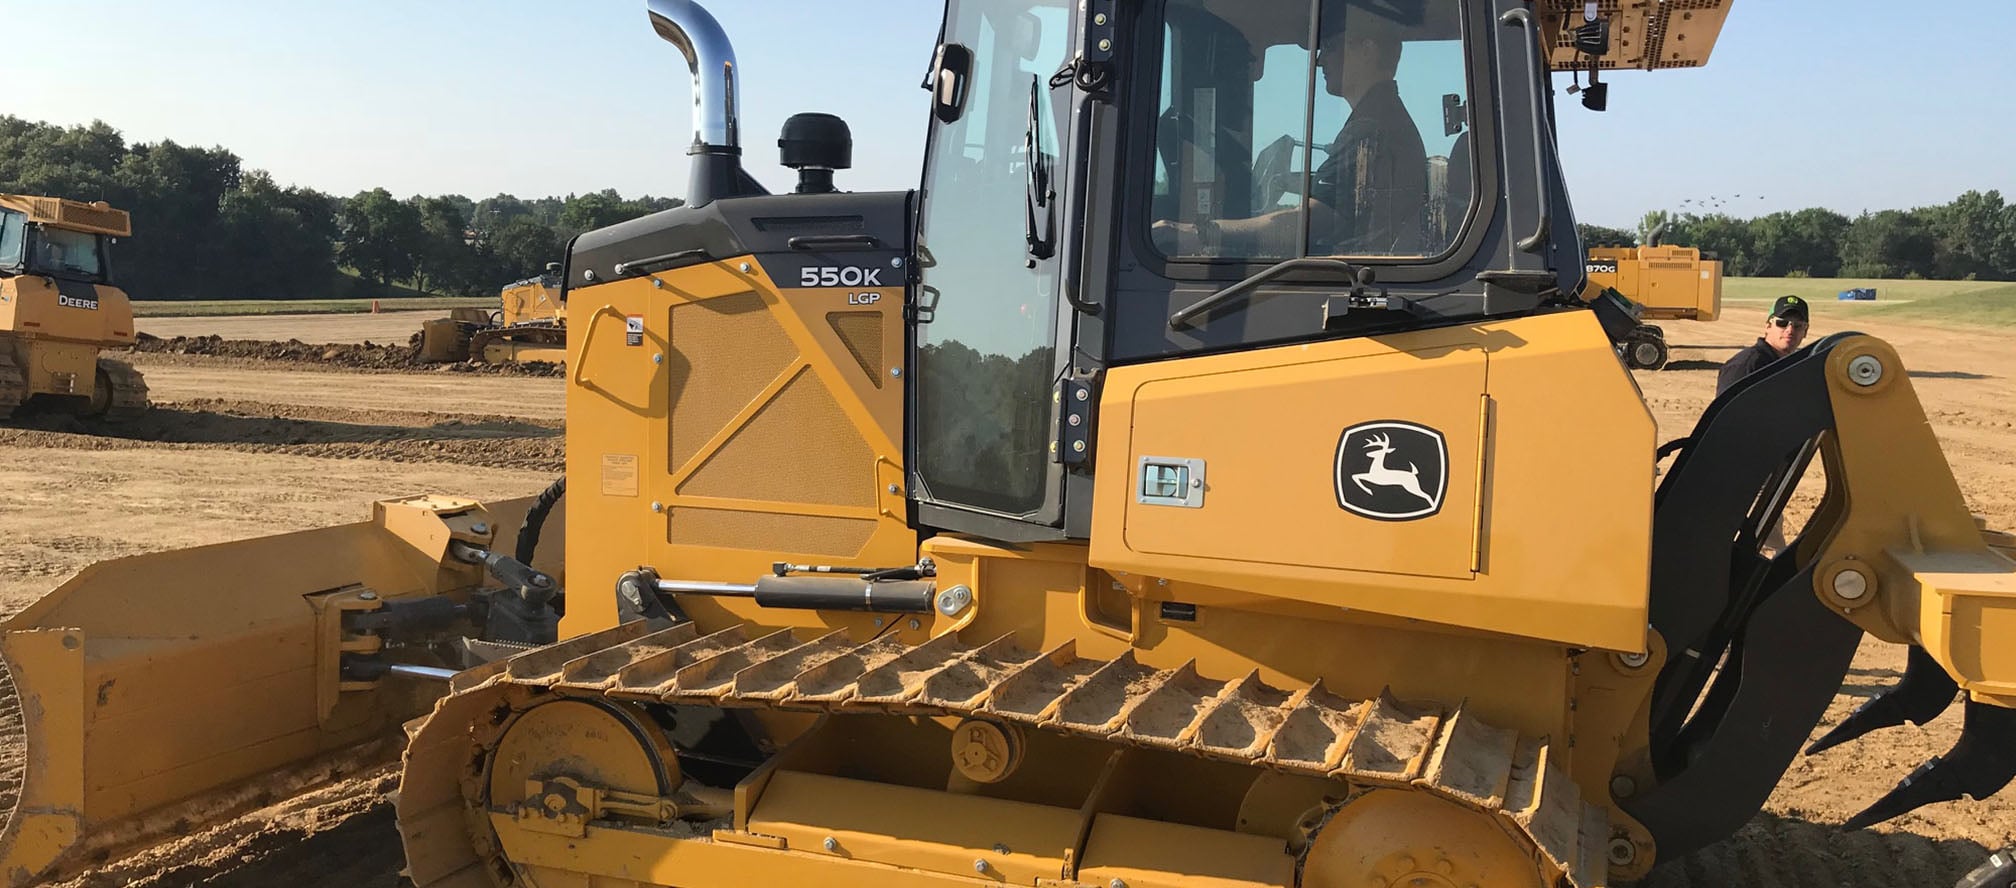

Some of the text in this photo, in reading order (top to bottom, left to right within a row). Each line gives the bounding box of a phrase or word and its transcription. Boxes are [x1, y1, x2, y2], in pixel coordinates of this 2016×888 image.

[1586, 264, 1616, 273] 870G
[801, 266, 882, 287] 550K
[59, 295, 98, 310] DEERE
[849, 293, 881, 305] LGP
